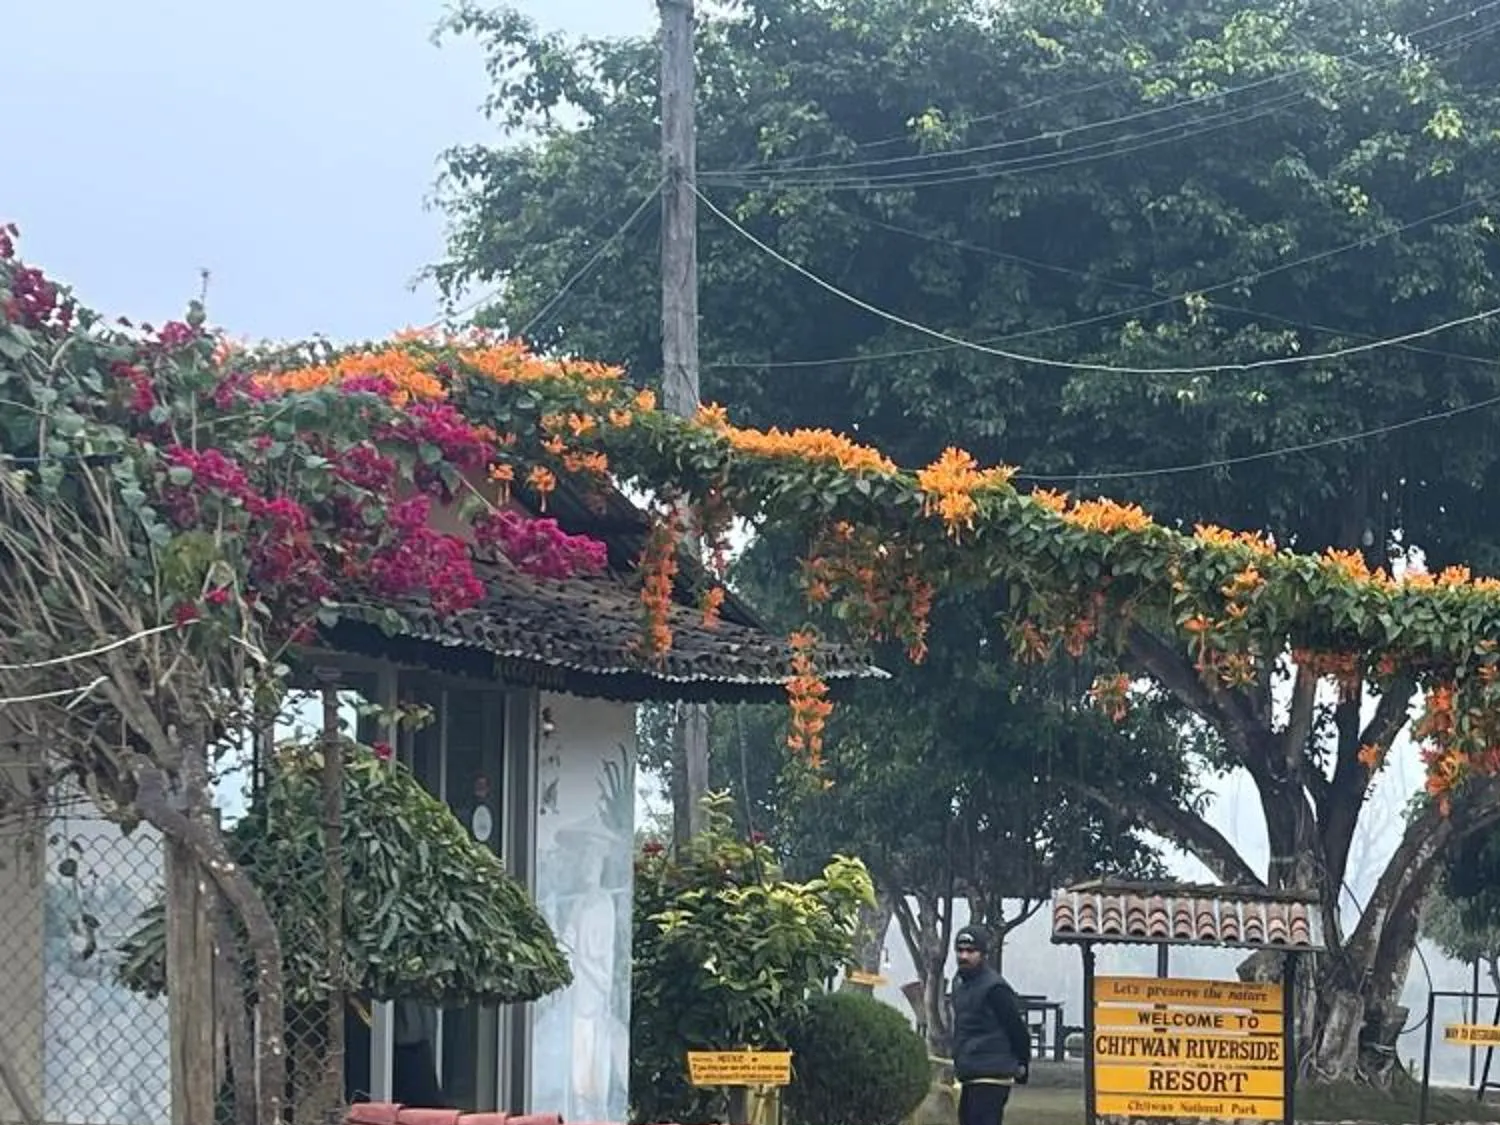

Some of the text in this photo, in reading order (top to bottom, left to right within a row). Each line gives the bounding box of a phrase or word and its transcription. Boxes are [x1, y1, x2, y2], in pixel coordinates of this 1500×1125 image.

[1113, 982, 1268, 1002] Let's preserve the nature
[1138, 1011, 1260, 1029] WELCOME TO
[1096, 1034, 1280, 1061] CHITWAN RIVERSIDE
[1149, 1069, 1249, 1092] RESORT
[1127, 1099, 1257, 1115] Chitwan National Park
